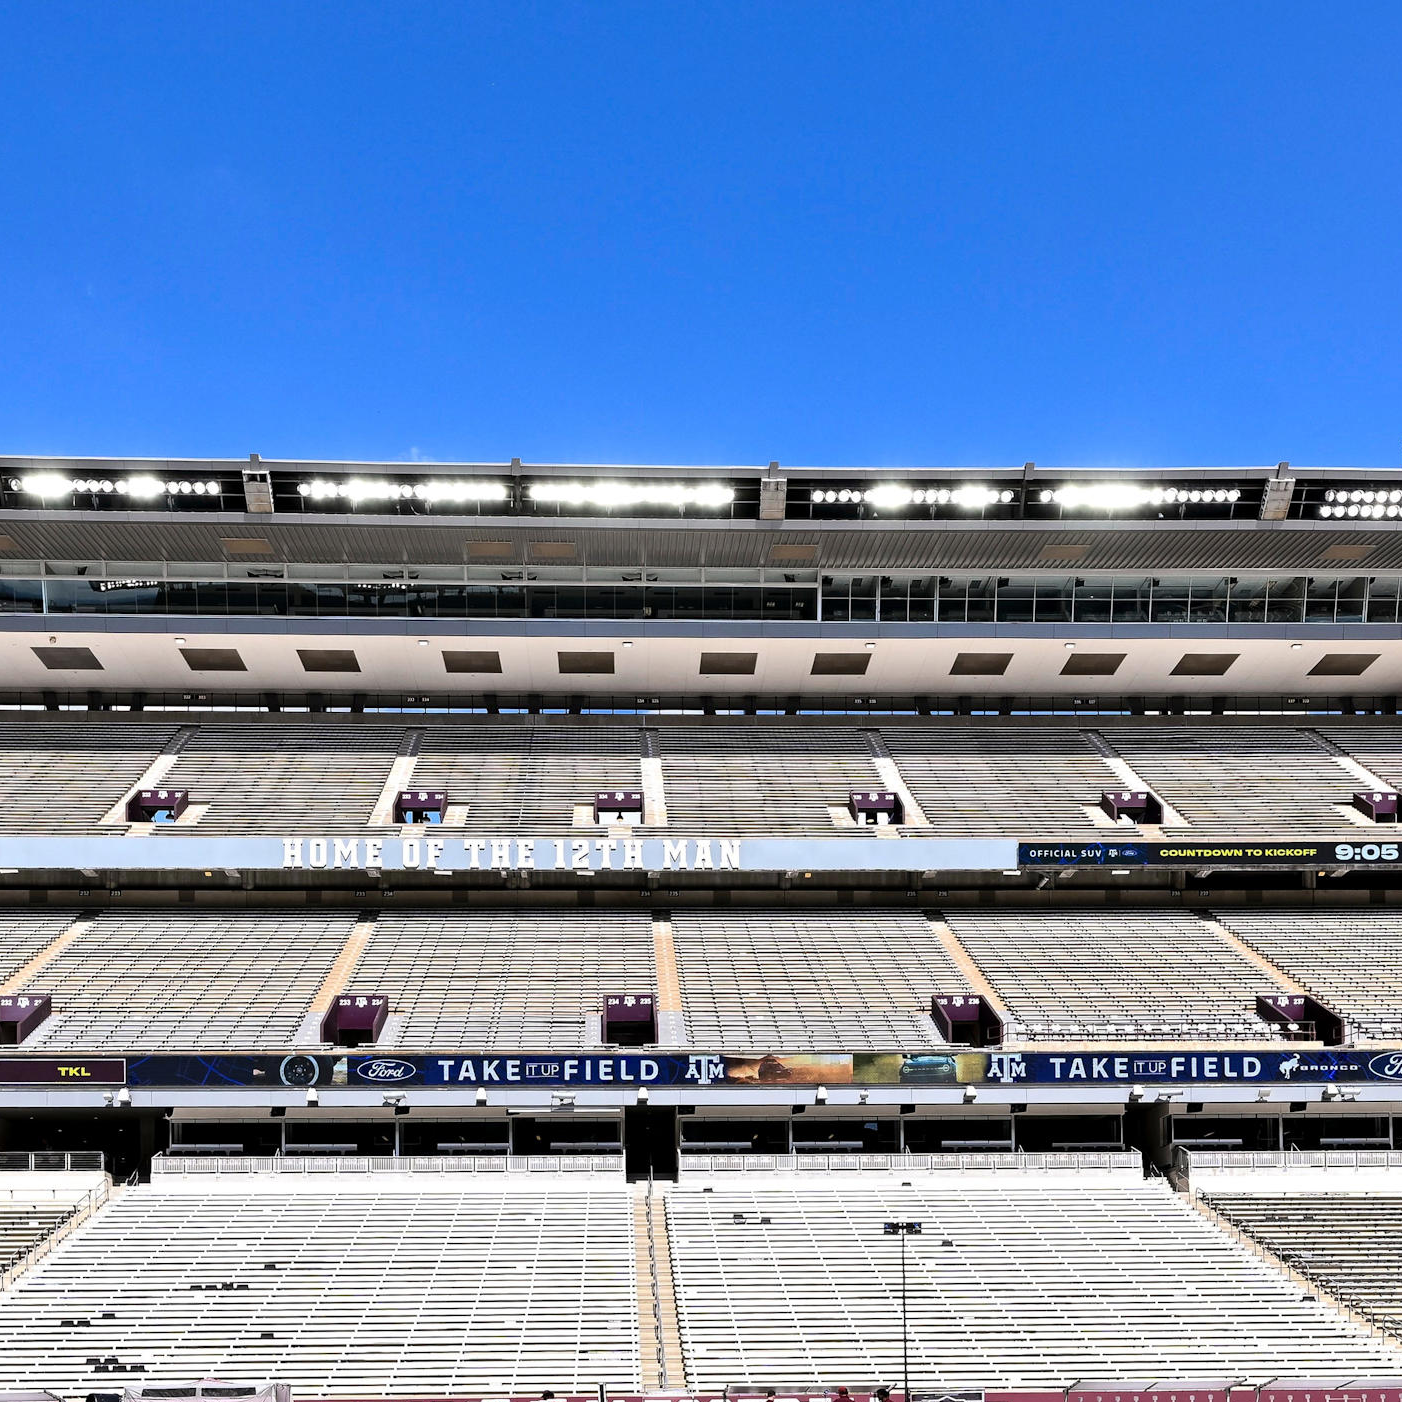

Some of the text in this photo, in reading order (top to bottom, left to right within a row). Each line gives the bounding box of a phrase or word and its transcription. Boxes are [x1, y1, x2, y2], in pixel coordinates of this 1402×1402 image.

[283, 838, 741, 870] HOME OF THE 12TH MAN
[1030, 849, 1077, 858] OFFICIAL
[1081, 849, 1102, 858] SUV
[1160, 848, 1317, 858] COUNTDOWN TO KICKOFF
[1335, 844, 1399, 860] 9:05
[57, 1067, 91, 1076] TKL
[368, 1061, 405, 1079] Ford
[439, 1059, 660, 1081] TAKE IT UP FIELD
[1049, 1056, 1261, 1078] TAKE IT UP FIELD
